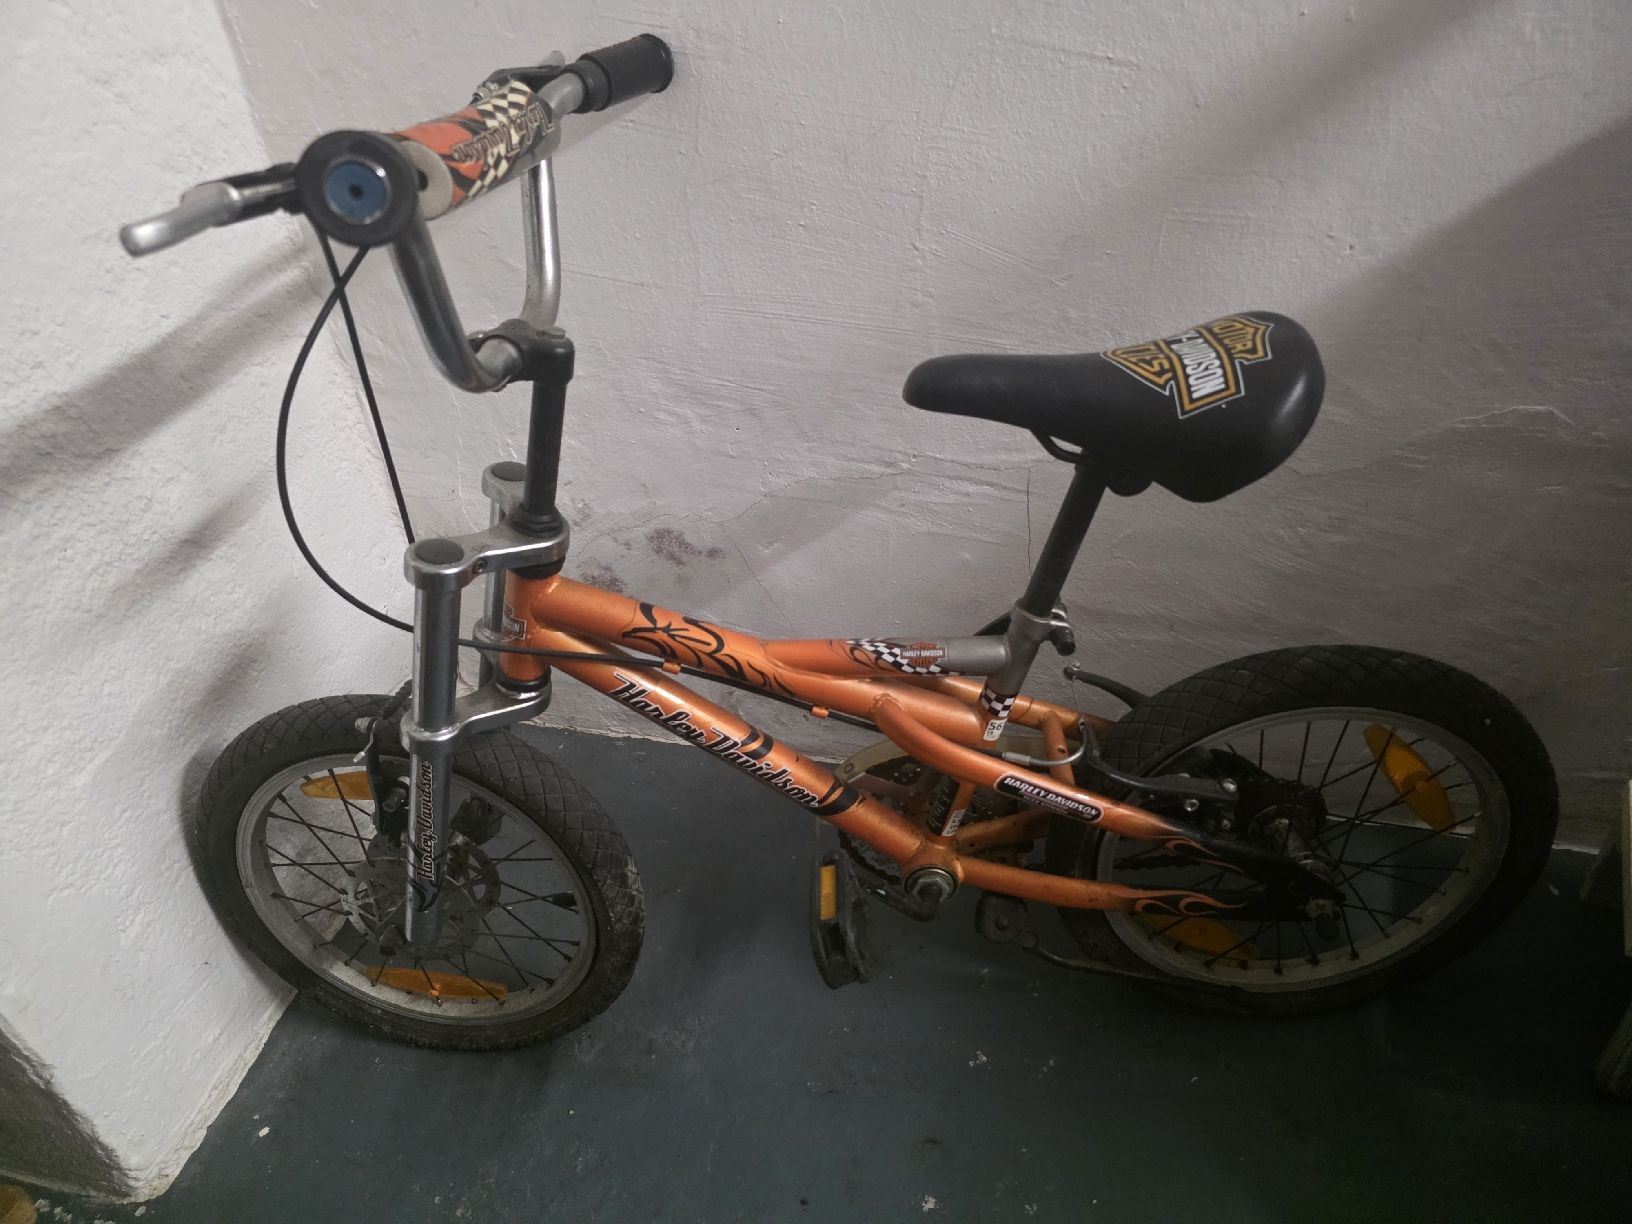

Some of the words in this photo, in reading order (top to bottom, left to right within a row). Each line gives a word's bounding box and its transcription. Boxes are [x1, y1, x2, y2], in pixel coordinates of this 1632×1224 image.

[614, 671, 707, 745] Harley
[702, 726, 819, 808] Davidson
[988, 721, 1003, 731] 56
[416, 760, 433, 832] Davidson
[1003, 777, 1046, 797] HARLEY
[1046, 793, 1099, 815] DAVIDSON
[415, 832, 438, 880] Harley
